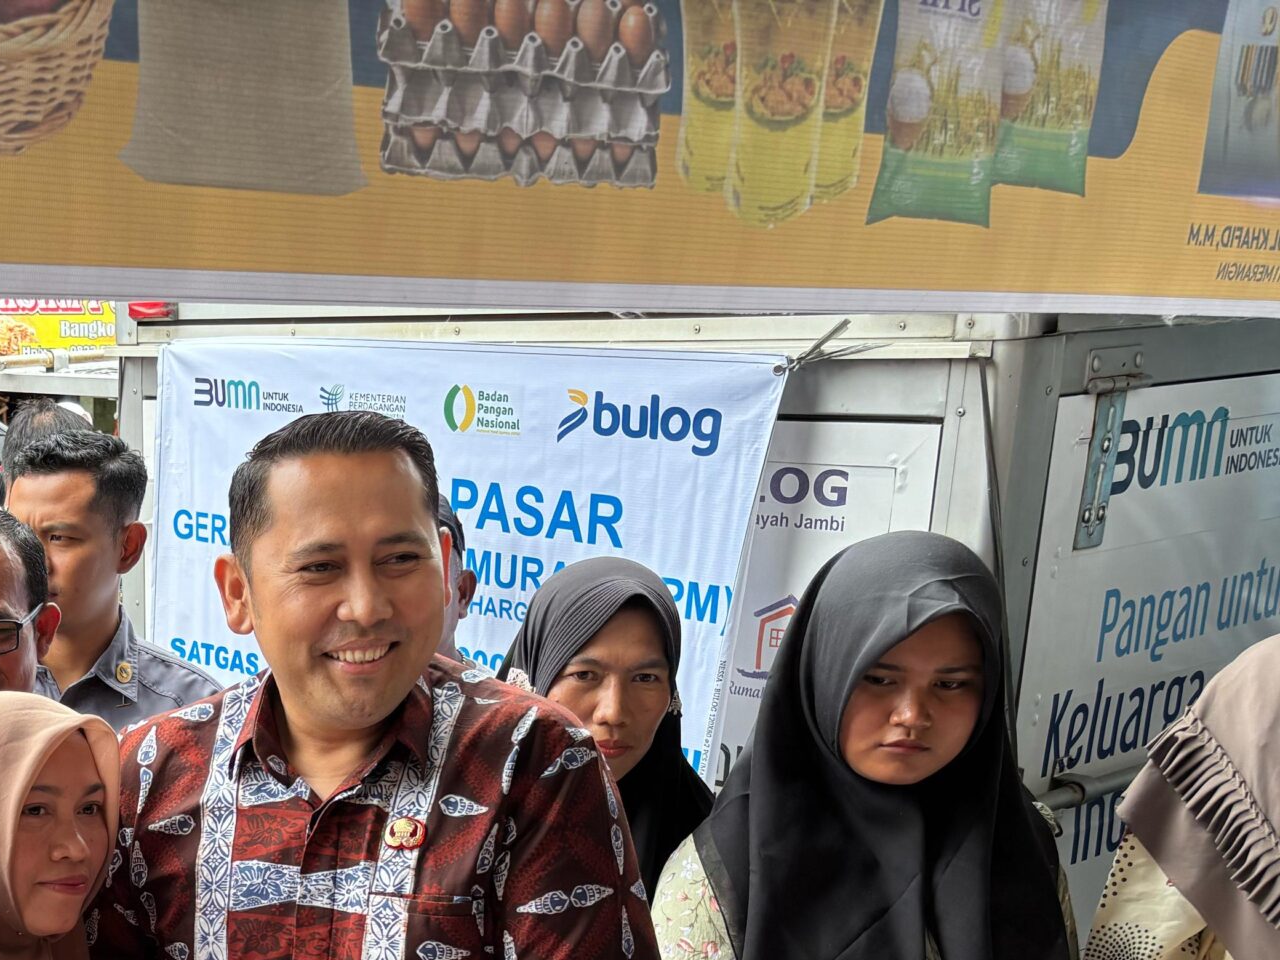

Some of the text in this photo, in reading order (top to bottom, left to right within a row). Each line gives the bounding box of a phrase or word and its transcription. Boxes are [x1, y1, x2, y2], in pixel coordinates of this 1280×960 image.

[262, 391, 289, 403] UNTUK
[348, 391, 407, 405] KEMENTERIAN
[348, 401, 406, 413] PERDAGANGAN
[478, 390, 509, 403] Badan
[262, 402, 304, 414] INDONESIA
[477, 403, 514, 416] Pangan
[476, 417, 520, 431] Nasional
[592, 390, 723, 457] bulog
[1229, 423, 1274, 449] UNTUK
[760, 466, 850, 508] OG
[451, 477, 624, 549] PASAR
[793, 513, 846, 532] Jambi
[173, 508, 232, 546] GER
[470, 595, 528, 623] HARG
[1096, 557, 1280, 663] Pangan untu
[170, 637, 260, 677] SATGAS
[715, 660, 728, 682] NESSA
[709, 687, 722, 711] BULOG
[728, 680, 766, 700] Ruma
